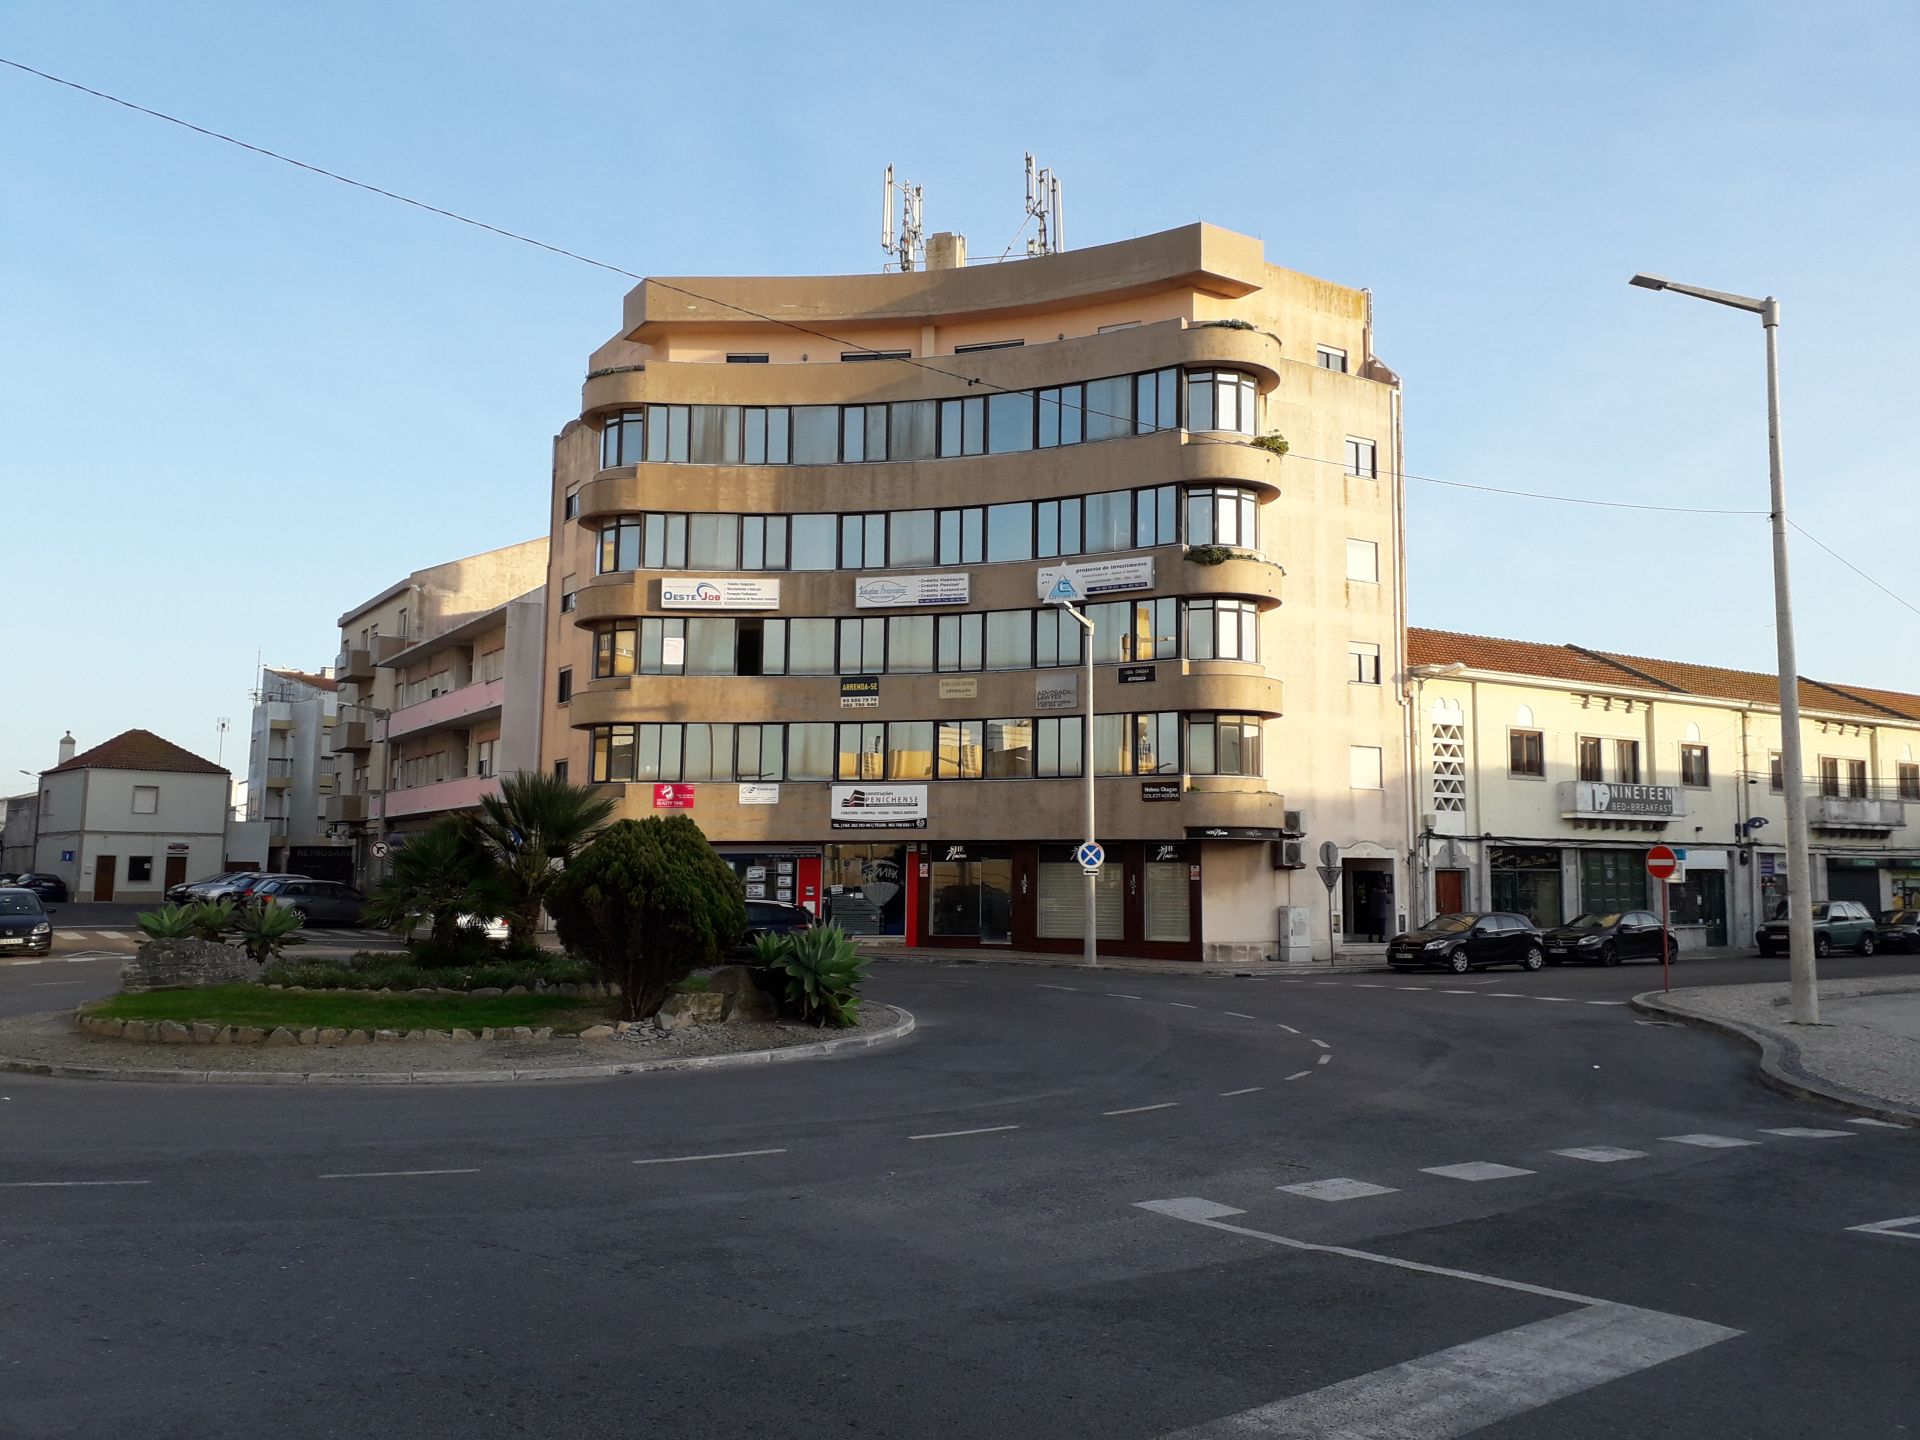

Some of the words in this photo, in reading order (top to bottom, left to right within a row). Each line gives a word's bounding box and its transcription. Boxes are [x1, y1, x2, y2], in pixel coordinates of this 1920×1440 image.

[664, 591, 696, 601] OESTE
[701, 592, 720, 601] JOB
[1611, 786, 1671, 800] NINETEEN
